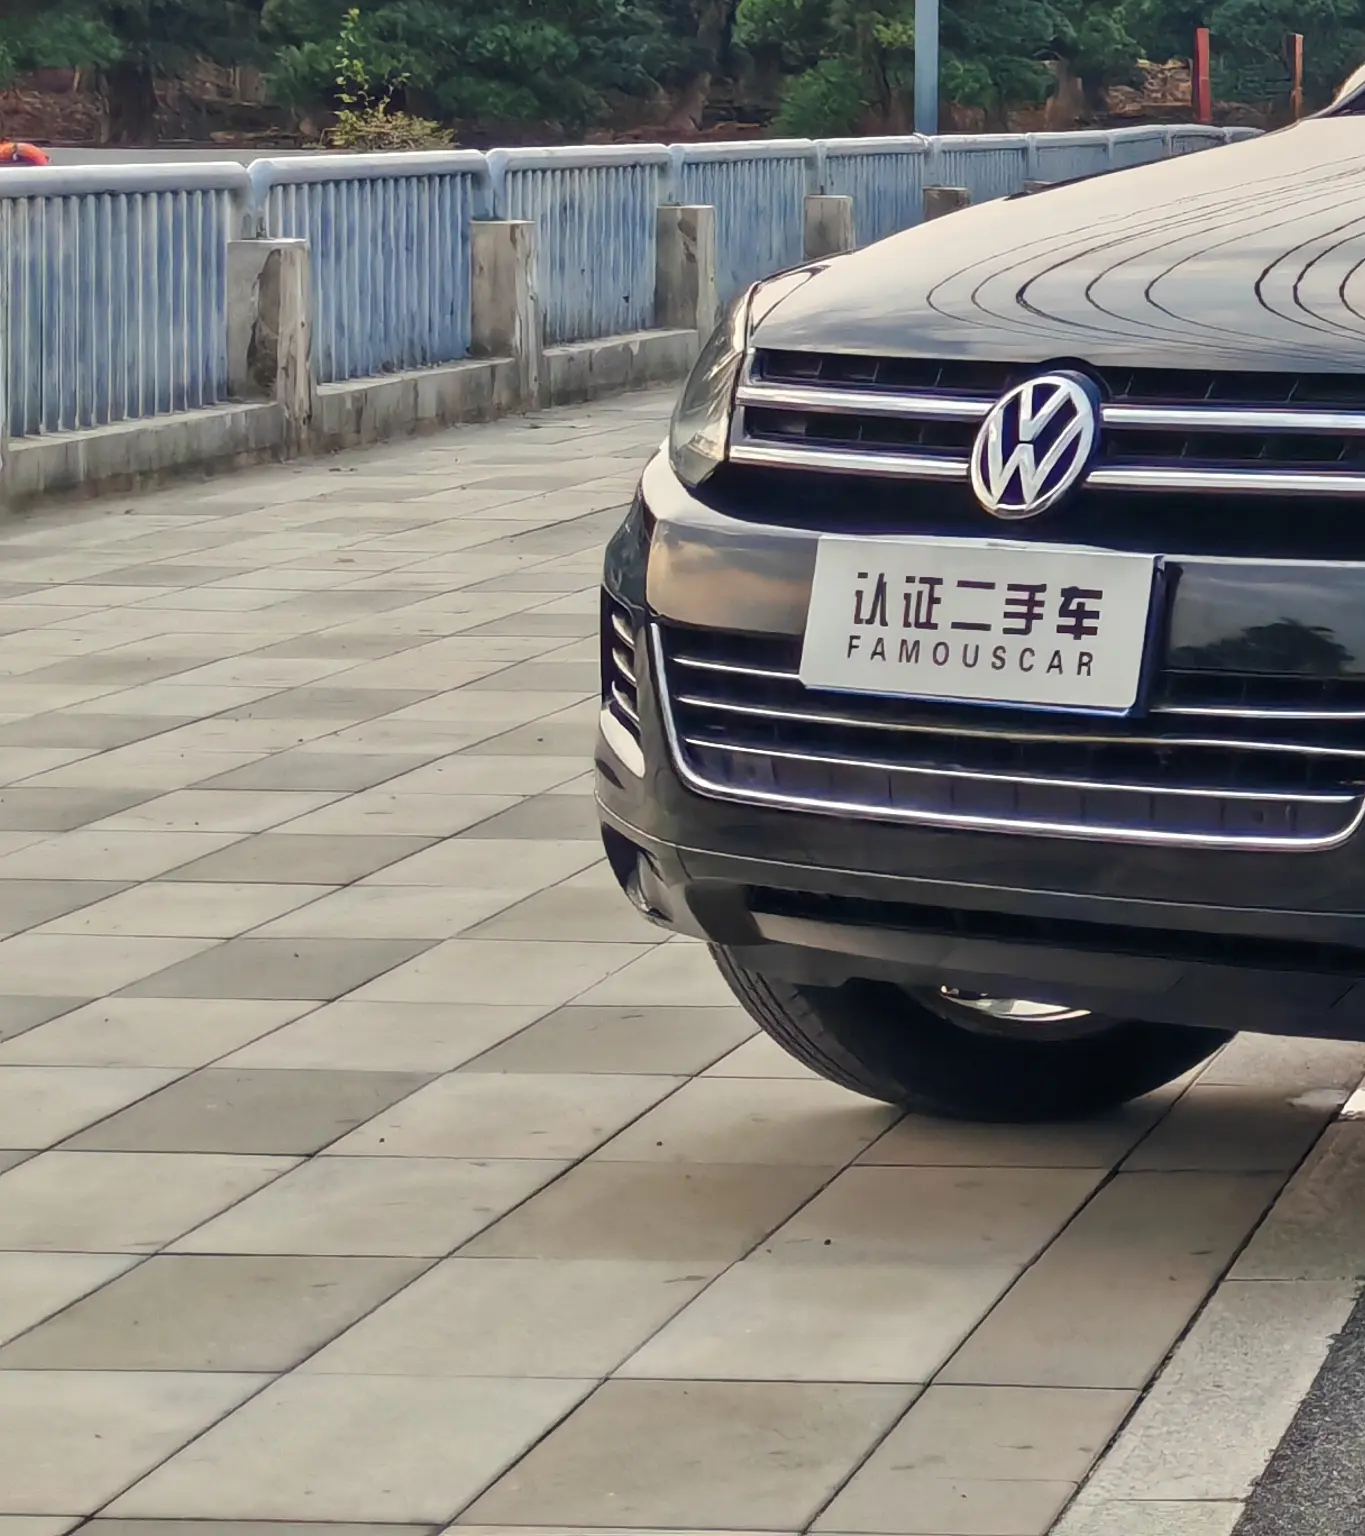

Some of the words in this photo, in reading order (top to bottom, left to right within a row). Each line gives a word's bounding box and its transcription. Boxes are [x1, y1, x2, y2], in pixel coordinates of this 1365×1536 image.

[973, 376, 1093, 516] VW
[853, 572, 1103, 640] 认证二手车
[847, 634, 1094, 677] FAMOUSCAR
